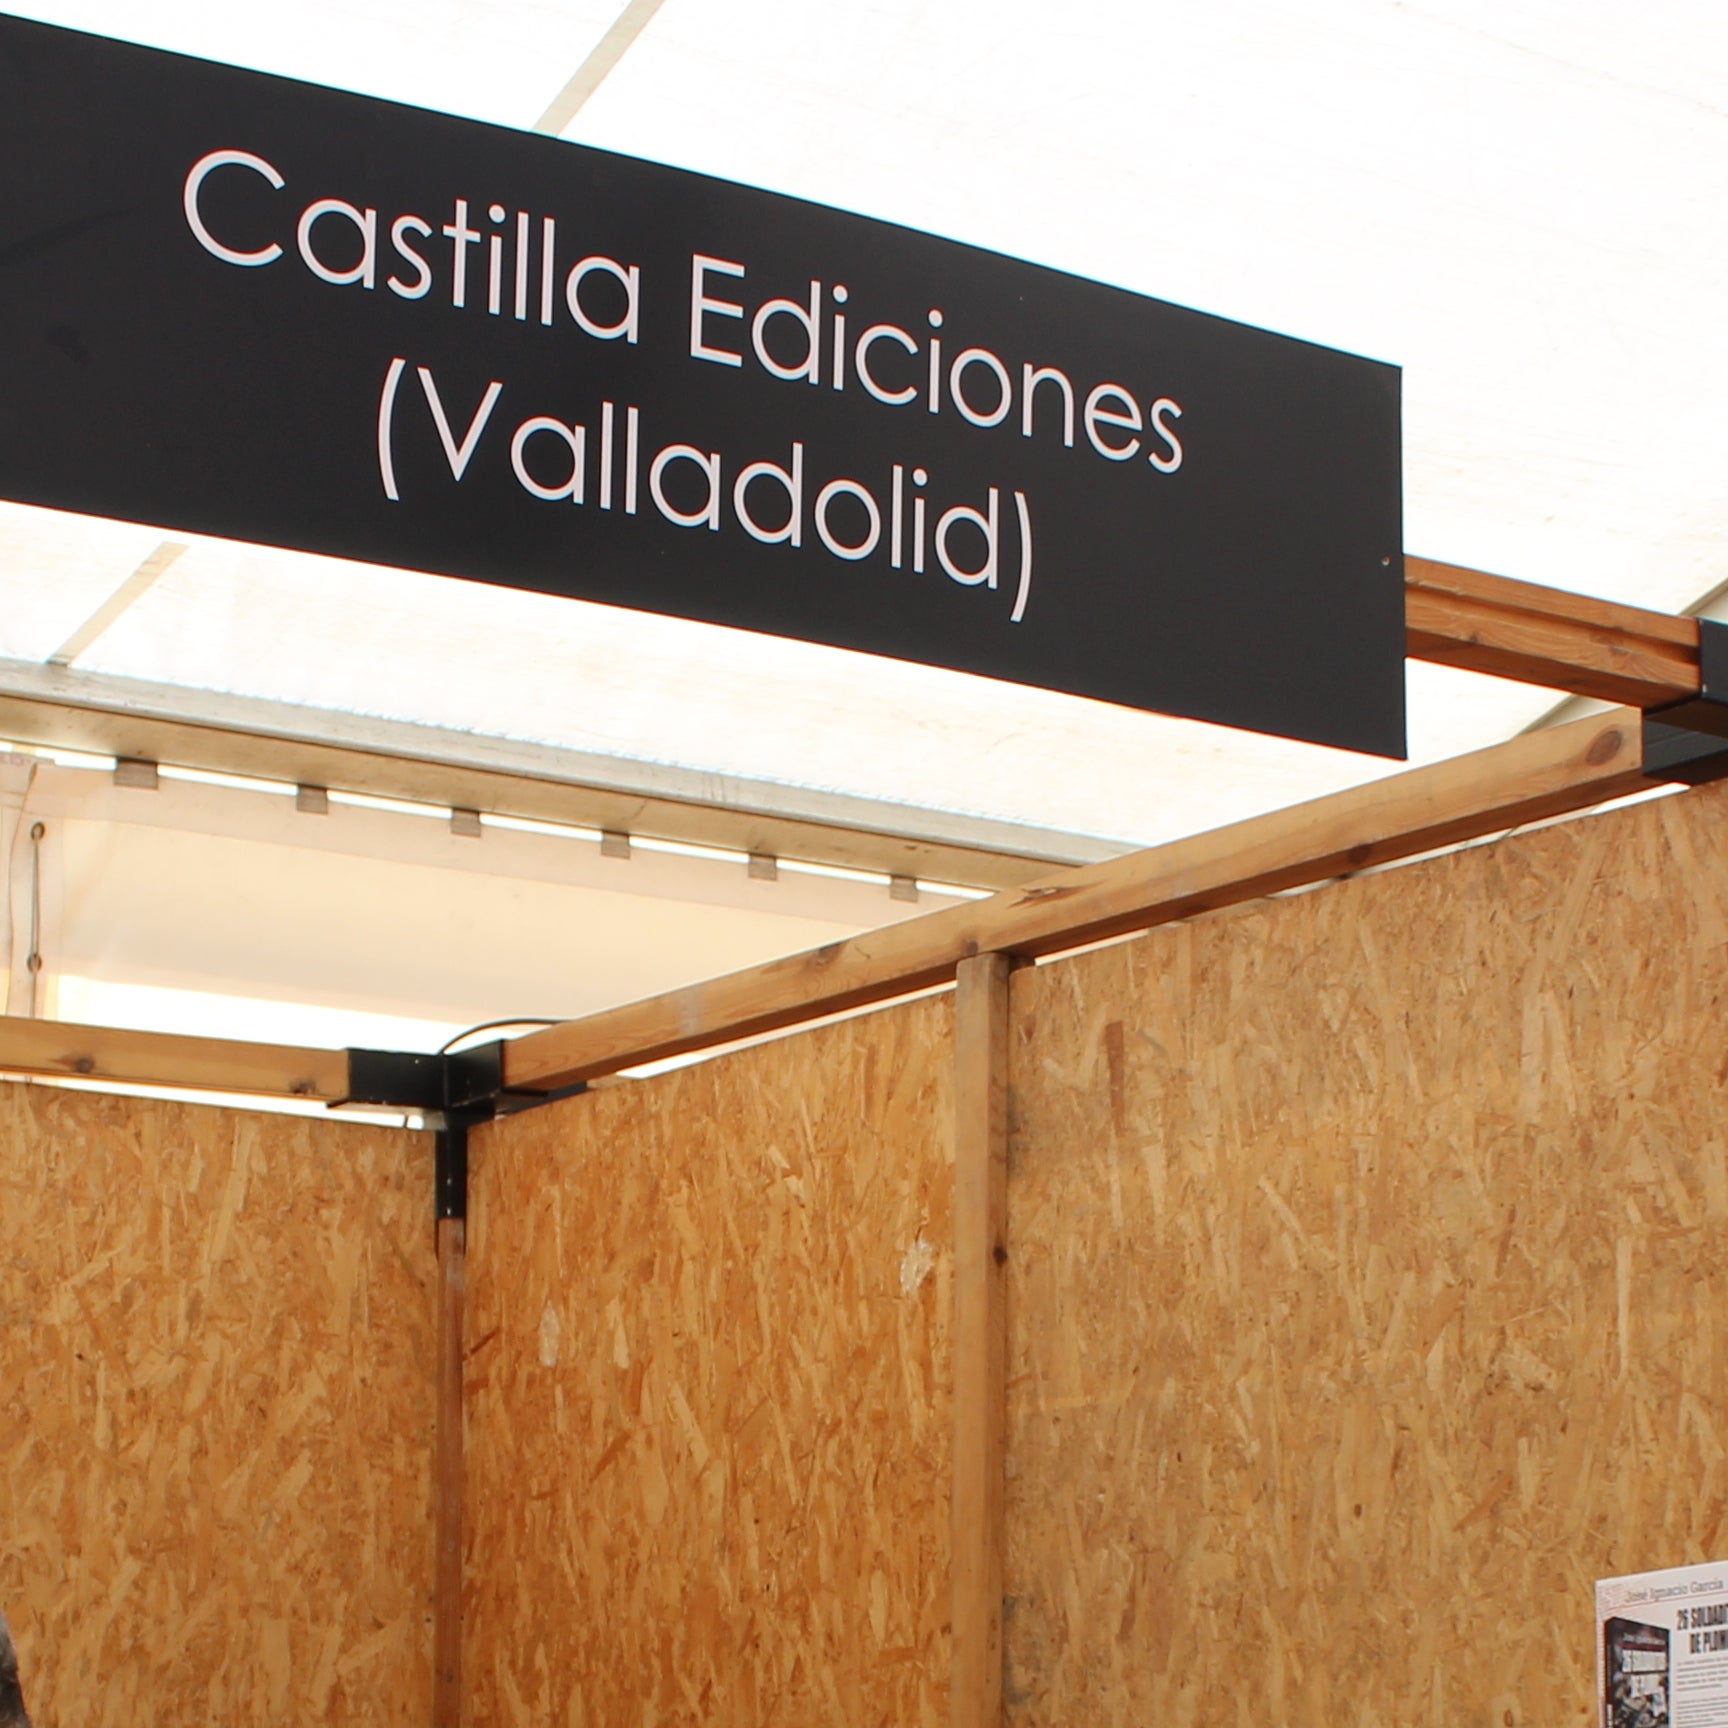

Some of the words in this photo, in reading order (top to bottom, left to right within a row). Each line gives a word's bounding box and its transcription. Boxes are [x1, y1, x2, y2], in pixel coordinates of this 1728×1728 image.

[183, 148, 641, 344] Castilla
[689, 252, 1184, 475] Ediciones
[376, 356, 1035, 622] (Valladolid)
